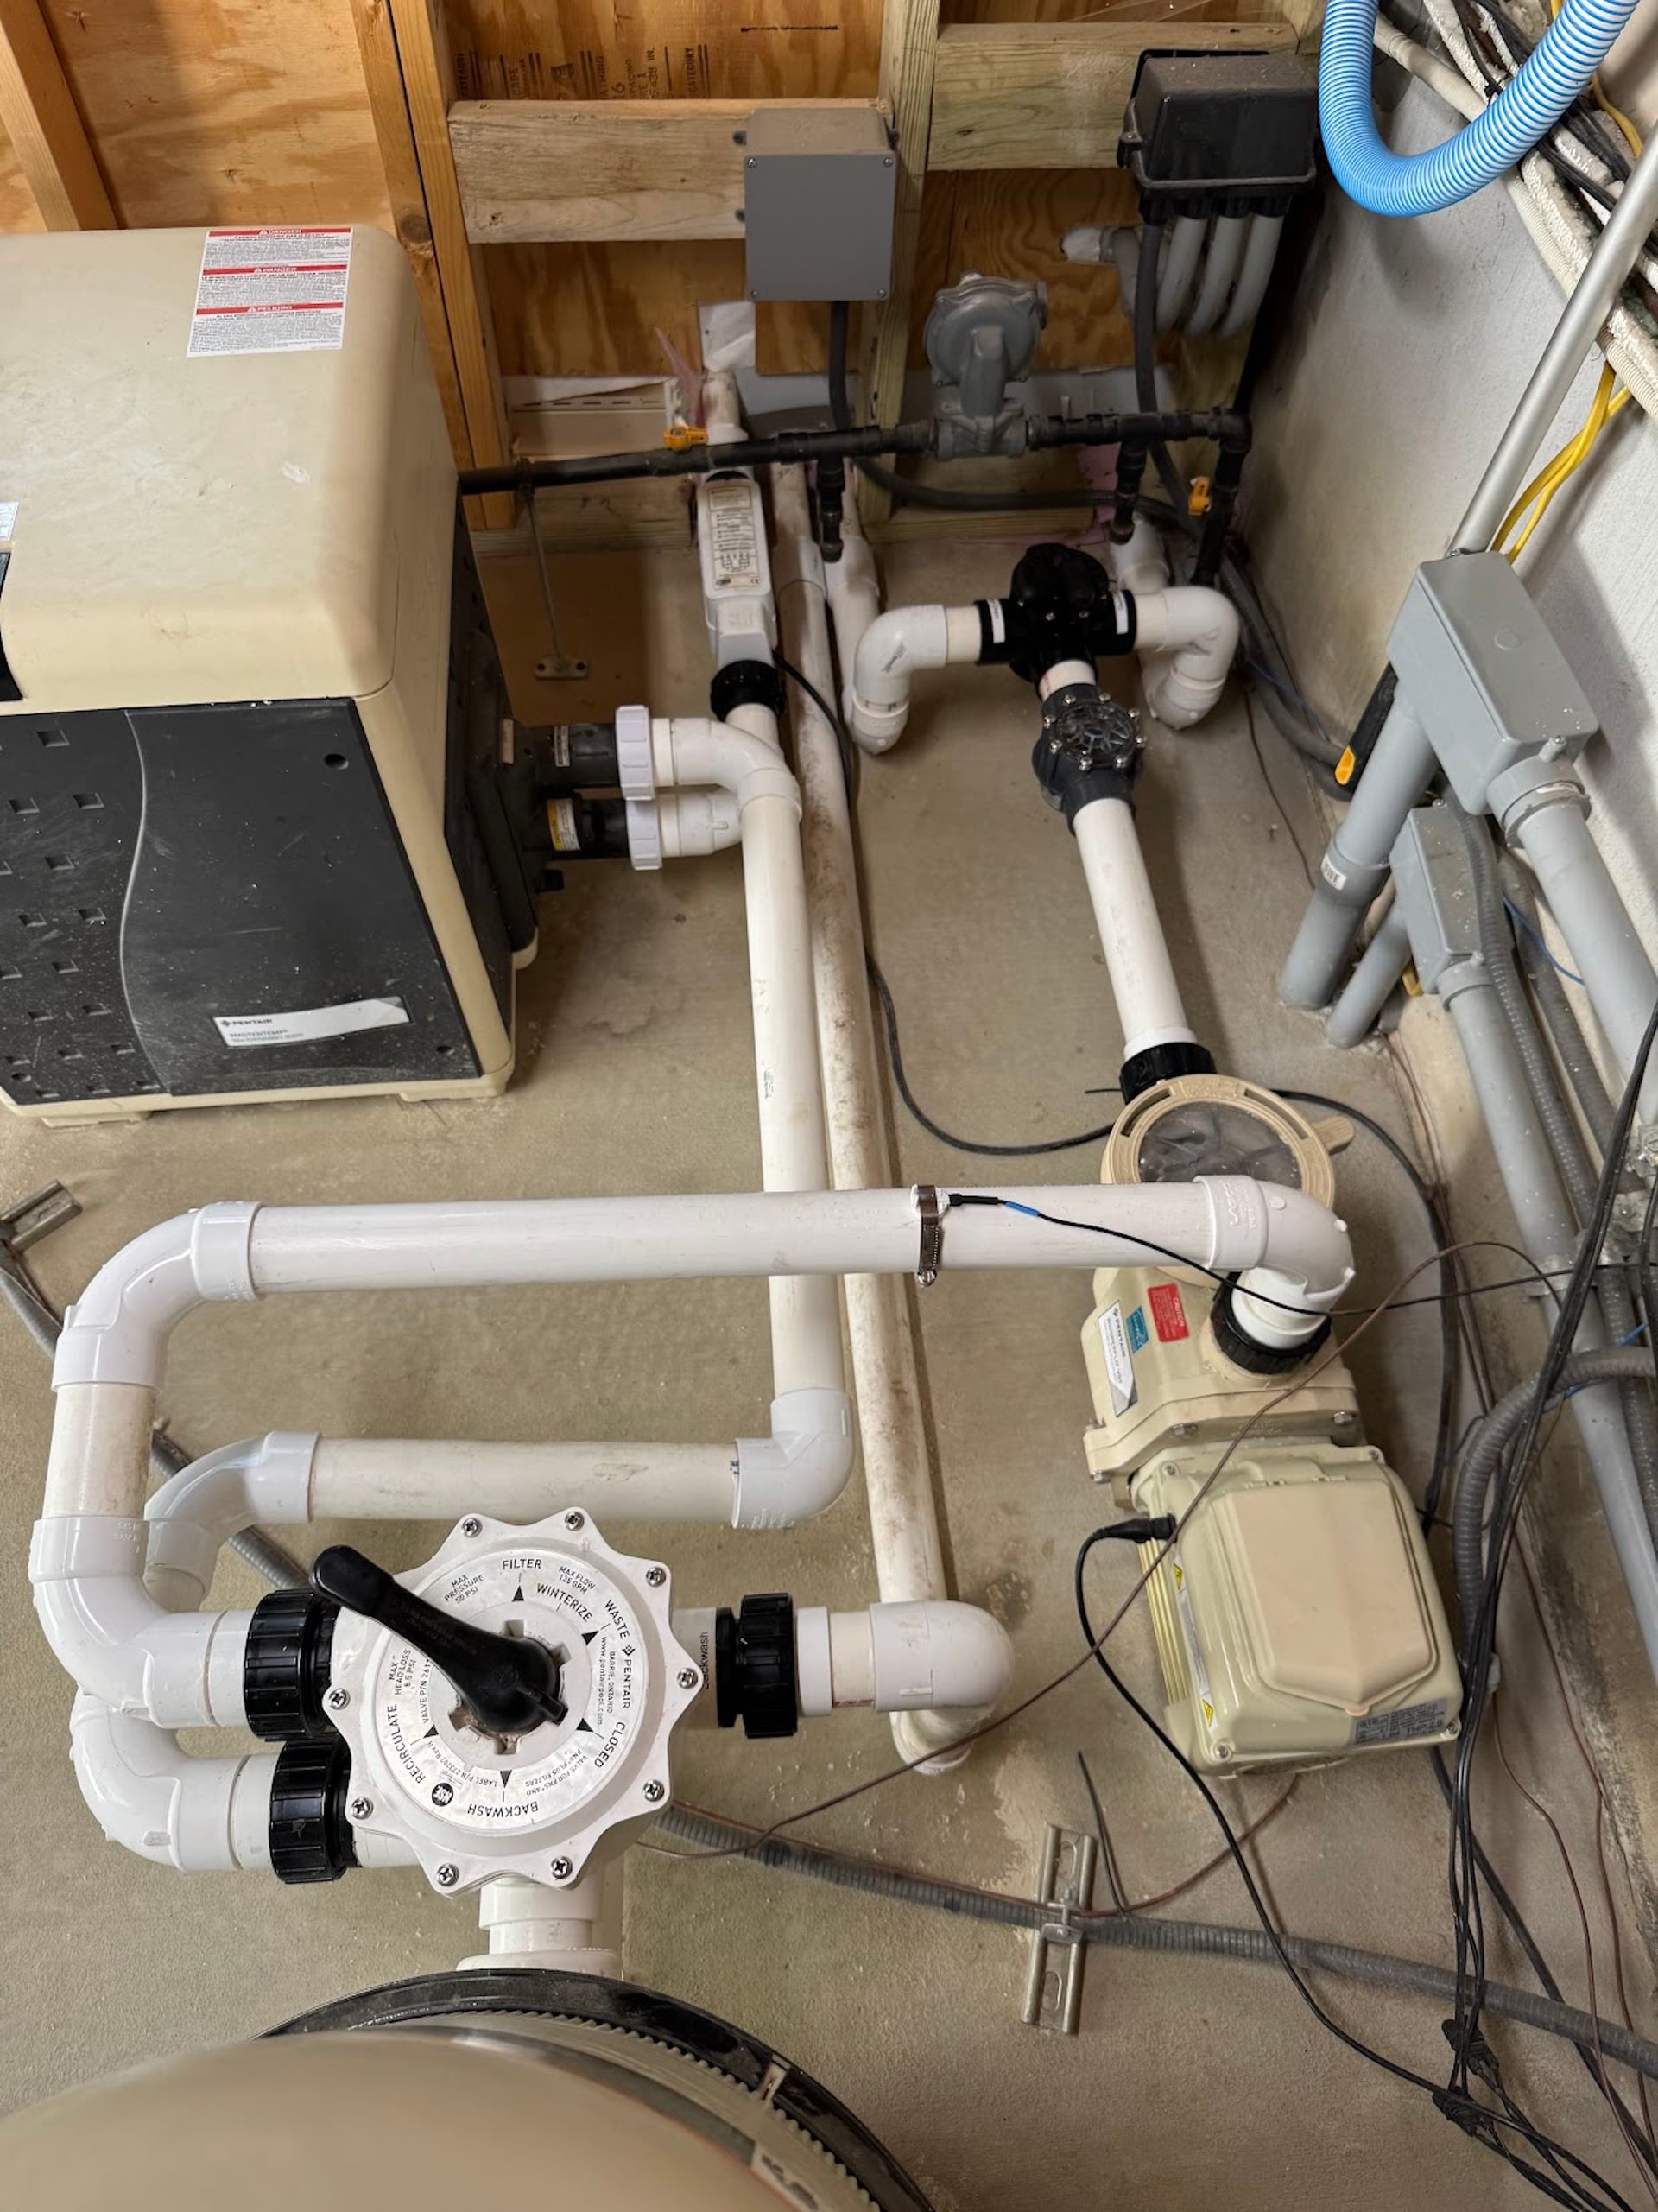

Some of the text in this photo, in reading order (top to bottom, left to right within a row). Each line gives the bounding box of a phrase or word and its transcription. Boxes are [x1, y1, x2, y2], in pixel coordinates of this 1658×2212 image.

[684, 47, 697, 92] CATEGORY
[502, 1558, 542, 1570] FILTER
[444, 1574, 485, 1602] PRESSURE
[451, 1574, 468, 1588] MAX
[559, 1565, 596, 1590] MAX FLOW
[560, 1574, 589, 1595] 125 GPM
[455, 1587, 479, 1604] 50 PSI
[536, 1582, 593, 1623] WINTERIZE
[604, 1599, 630, 1640] WASTE
[389, 1662, 400, 1681] MAX
[395, 1649, 412, 1695] HEAD LOSS
[407, 1658, 416, 1673] PSI
[419, 1681, 428, 1697] P/N
[622, 1658, 634, 1710] PENTAIR
[606, 1682, 617, 1714] ONTARIO
[419, 1697, 429, 1725] VALVE
[387, 1703, 427, 1784] RECIRCULATE
[594, 1721, 626, 1768] CLOSED
[475, 1777, 497, 1788] LABEL
[525, 1769, 554, 1787] FILTERS
[467, 1800, 539, 1818] BACKWASH
